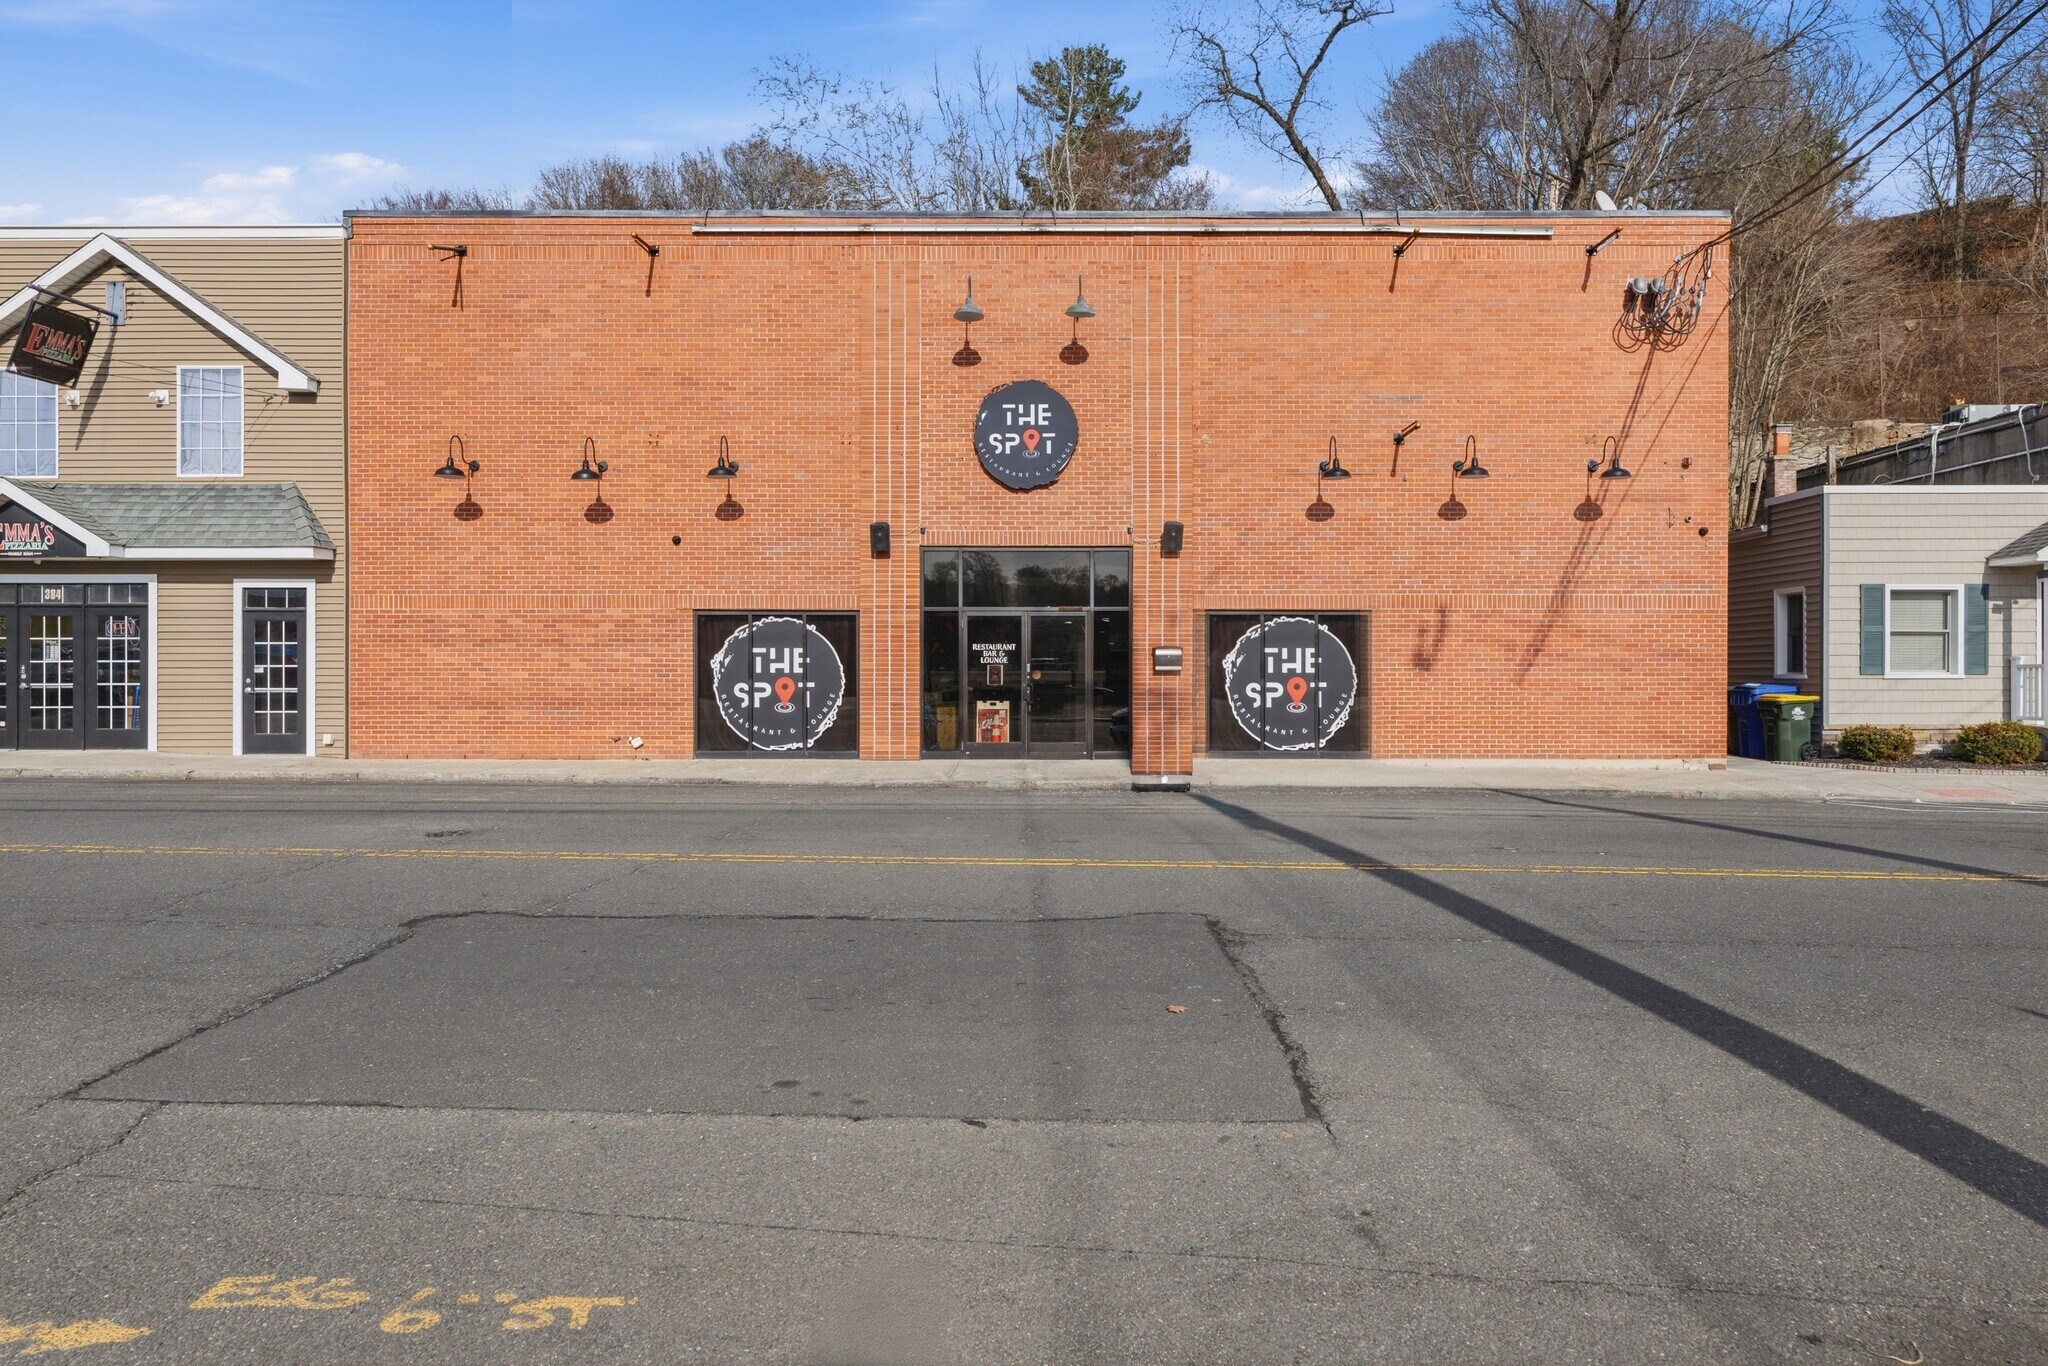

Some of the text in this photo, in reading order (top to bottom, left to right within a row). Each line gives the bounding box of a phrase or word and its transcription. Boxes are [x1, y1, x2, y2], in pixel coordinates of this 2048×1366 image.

[22, 322, 86, 360] EMMA'S
[1002, 404, 1052, 426] THE
[978, 442, 1030, 477] RESTAURANT
[1045, 442, 1073, 472] LOUNGE
[44, 588, 62, 600] 384
[107, 622, 134, 635] OPEN
[972, 643, 1016, 651] RESTAURANT
[752, 647, 810, 674] THE
[980, 656, 1009, 664] LOUNGE
[1264, 647, 1322, 674] THE
